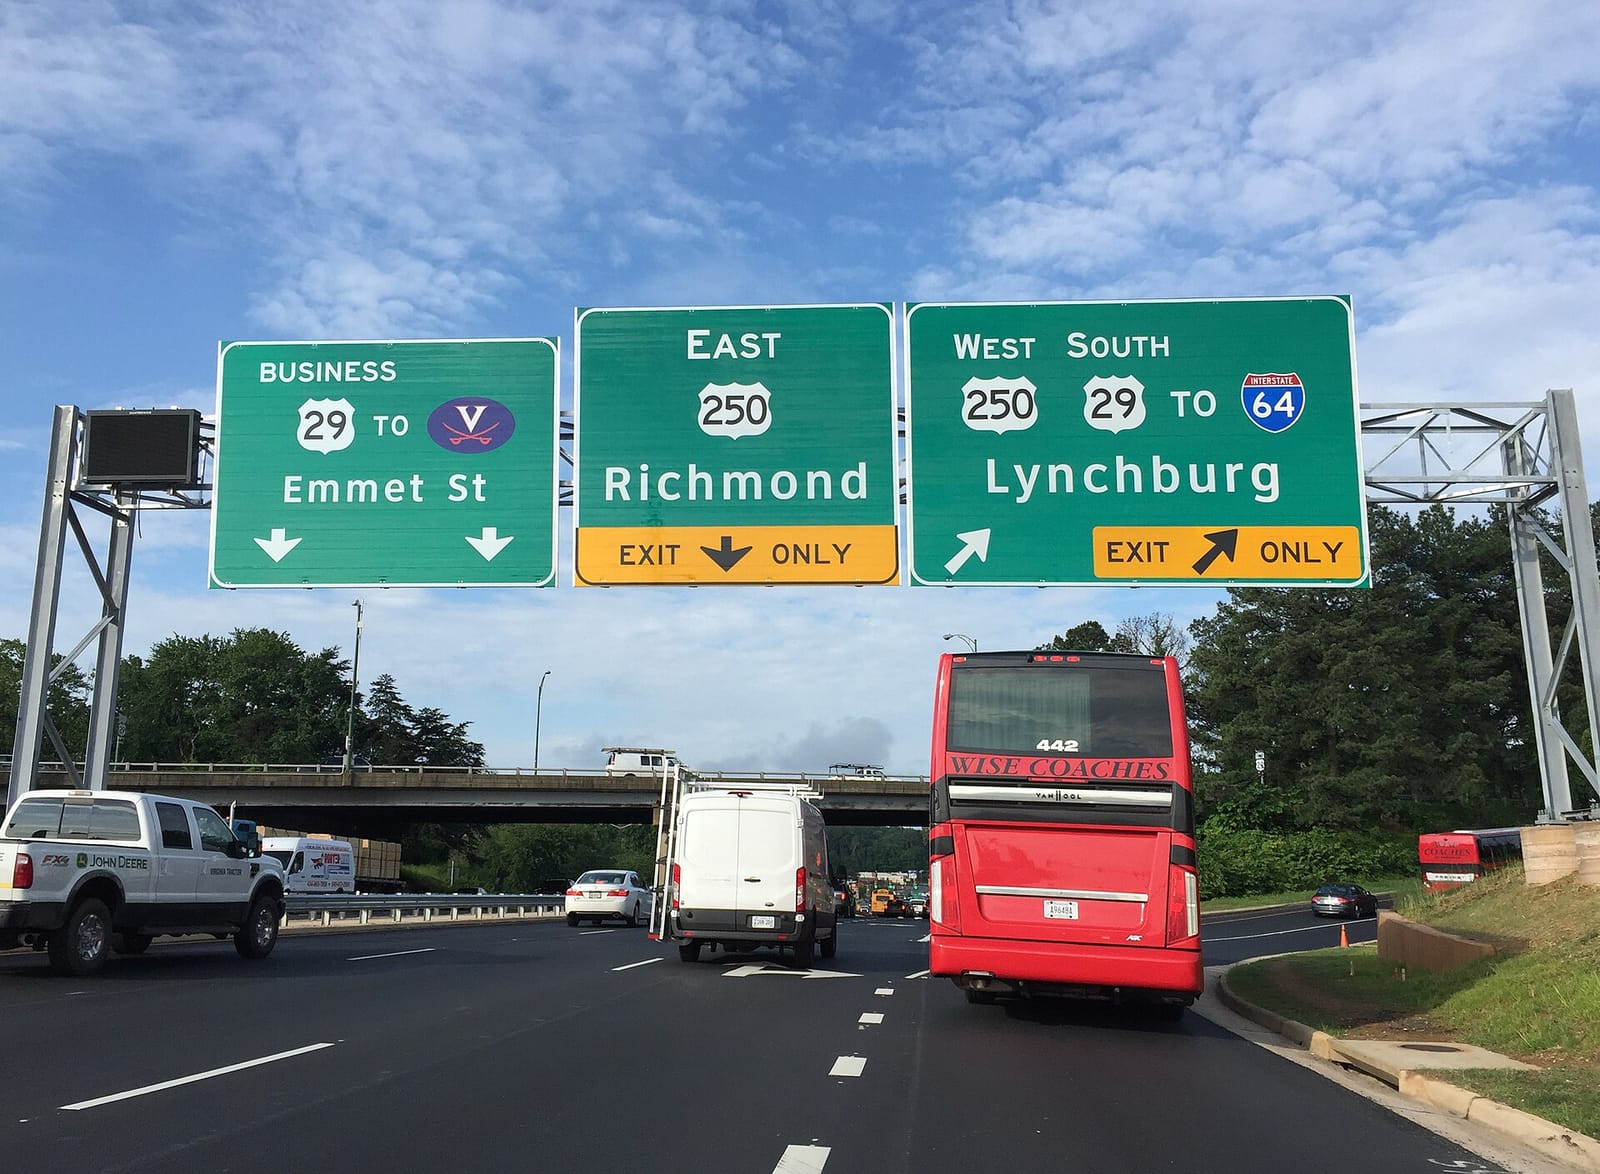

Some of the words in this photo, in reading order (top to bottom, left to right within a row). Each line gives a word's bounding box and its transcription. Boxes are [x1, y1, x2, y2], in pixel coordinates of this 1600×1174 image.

[687, 329, 781, 360] EAST
[953, 332, 1036, 360] WEST
[1066, 332, 1170, 359] SOUTH
[259, 361, 398, 383] BUSINESS
[1250, 376, 1294, 385] INTERSTATE
[702, 394, 768, 425] 250
[966, 388, 1034, 421] 250
[1090, 388, 1137, 419] 29
[1170, 390, 1217, 417] TO
[1252, 391, 1295, 418] 64
[303, 410, 348, 440] 29
[373, 415, 409, 436] TO
[455, 405, 488, 433] V
[283, 474, 424, 503] Emmet
[448, 473, 487, 502] St
[604, 462, 867, 501] Richmond
[986, 455, 1280, 503] Lynchburg
[620, 544, 681, 565] EXIT
[772, 543, 852, 564] ONLY
[1107, 542, 1170, 562] EXIT
[1260, 542, 1344, 563] ONLY
[1036, 739, 1079, 752] 442
[951, 756, 1021, 775] WISE
[1029, 758, 1169, 780] COACHES
[90, 855, 117, 867] JOHN
[118, 856, 148, 869] DEERE
